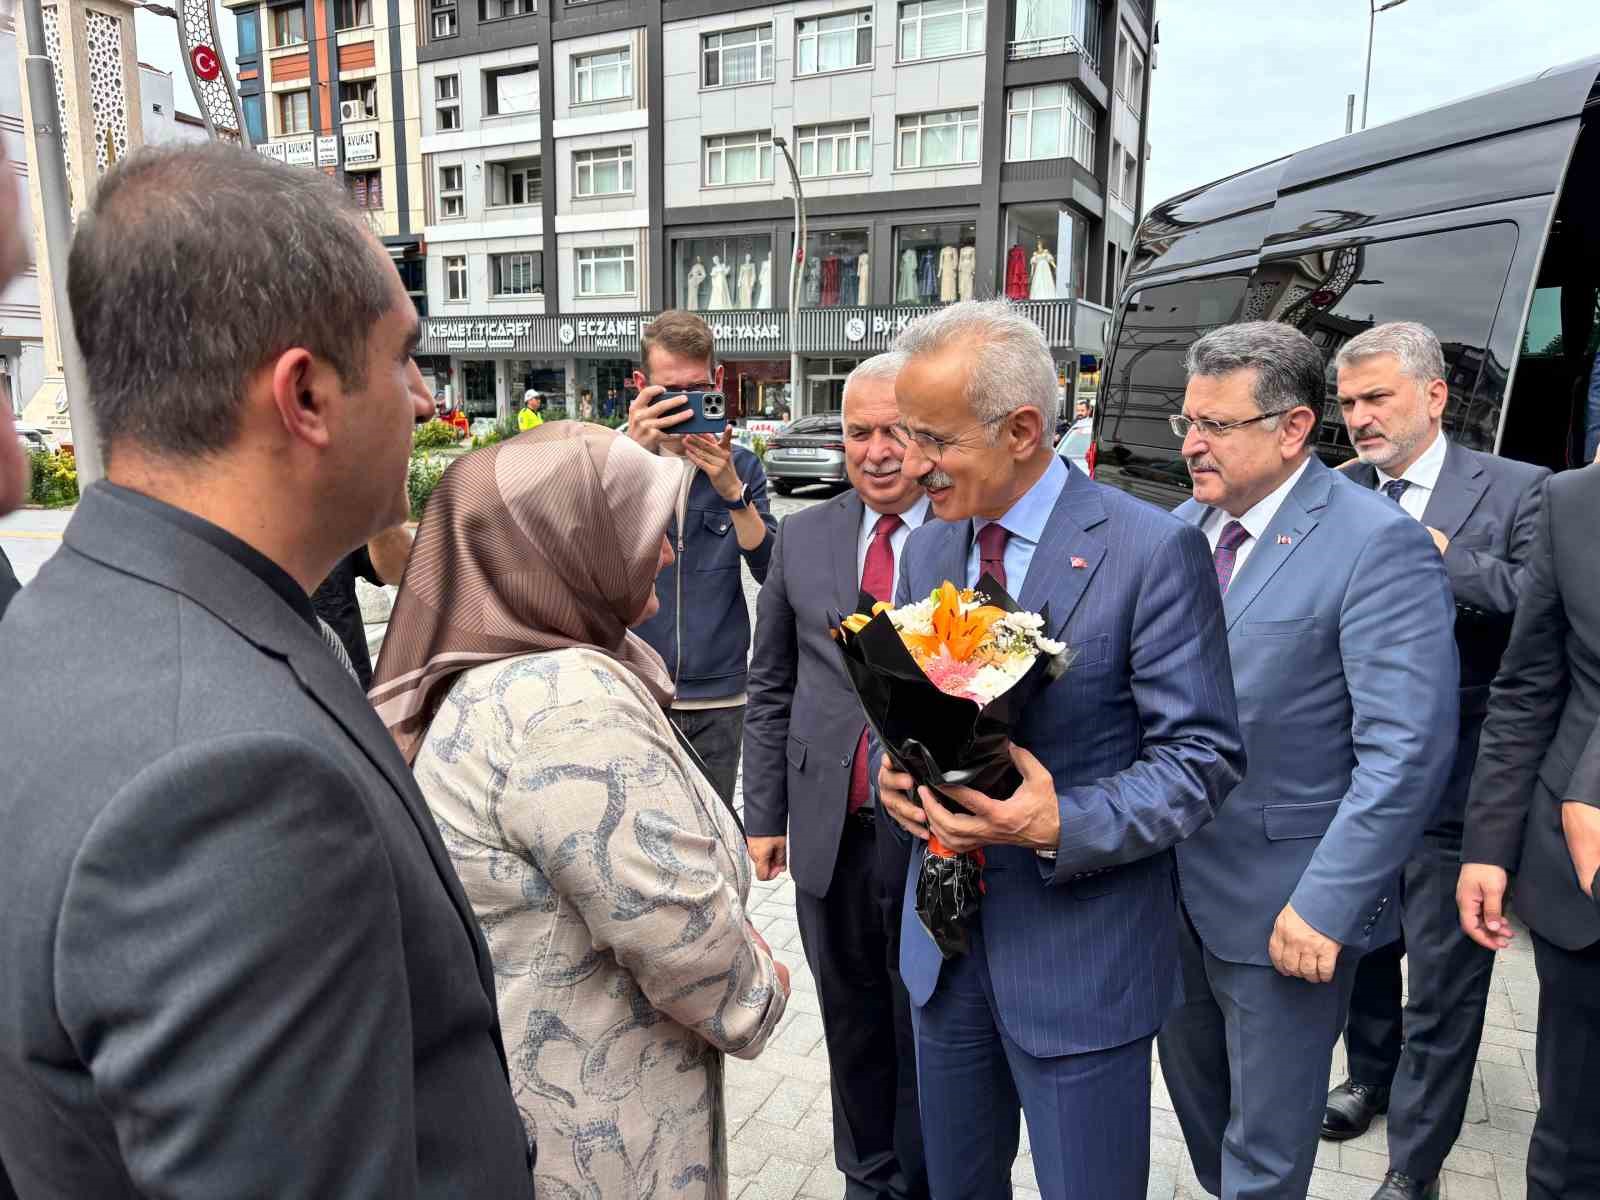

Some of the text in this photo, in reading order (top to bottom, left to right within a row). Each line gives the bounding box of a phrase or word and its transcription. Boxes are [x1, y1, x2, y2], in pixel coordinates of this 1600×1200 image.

[288, 141, 312, 153] AVUKAT
[348, 133, 373, 147] AVUKAT
[428, 323, 473, 337] KISMET
[578, 320, 636, 336] ECZANE
[736, 325, 780, 342] YAŞAR
[873, 316, 891, 336] By
